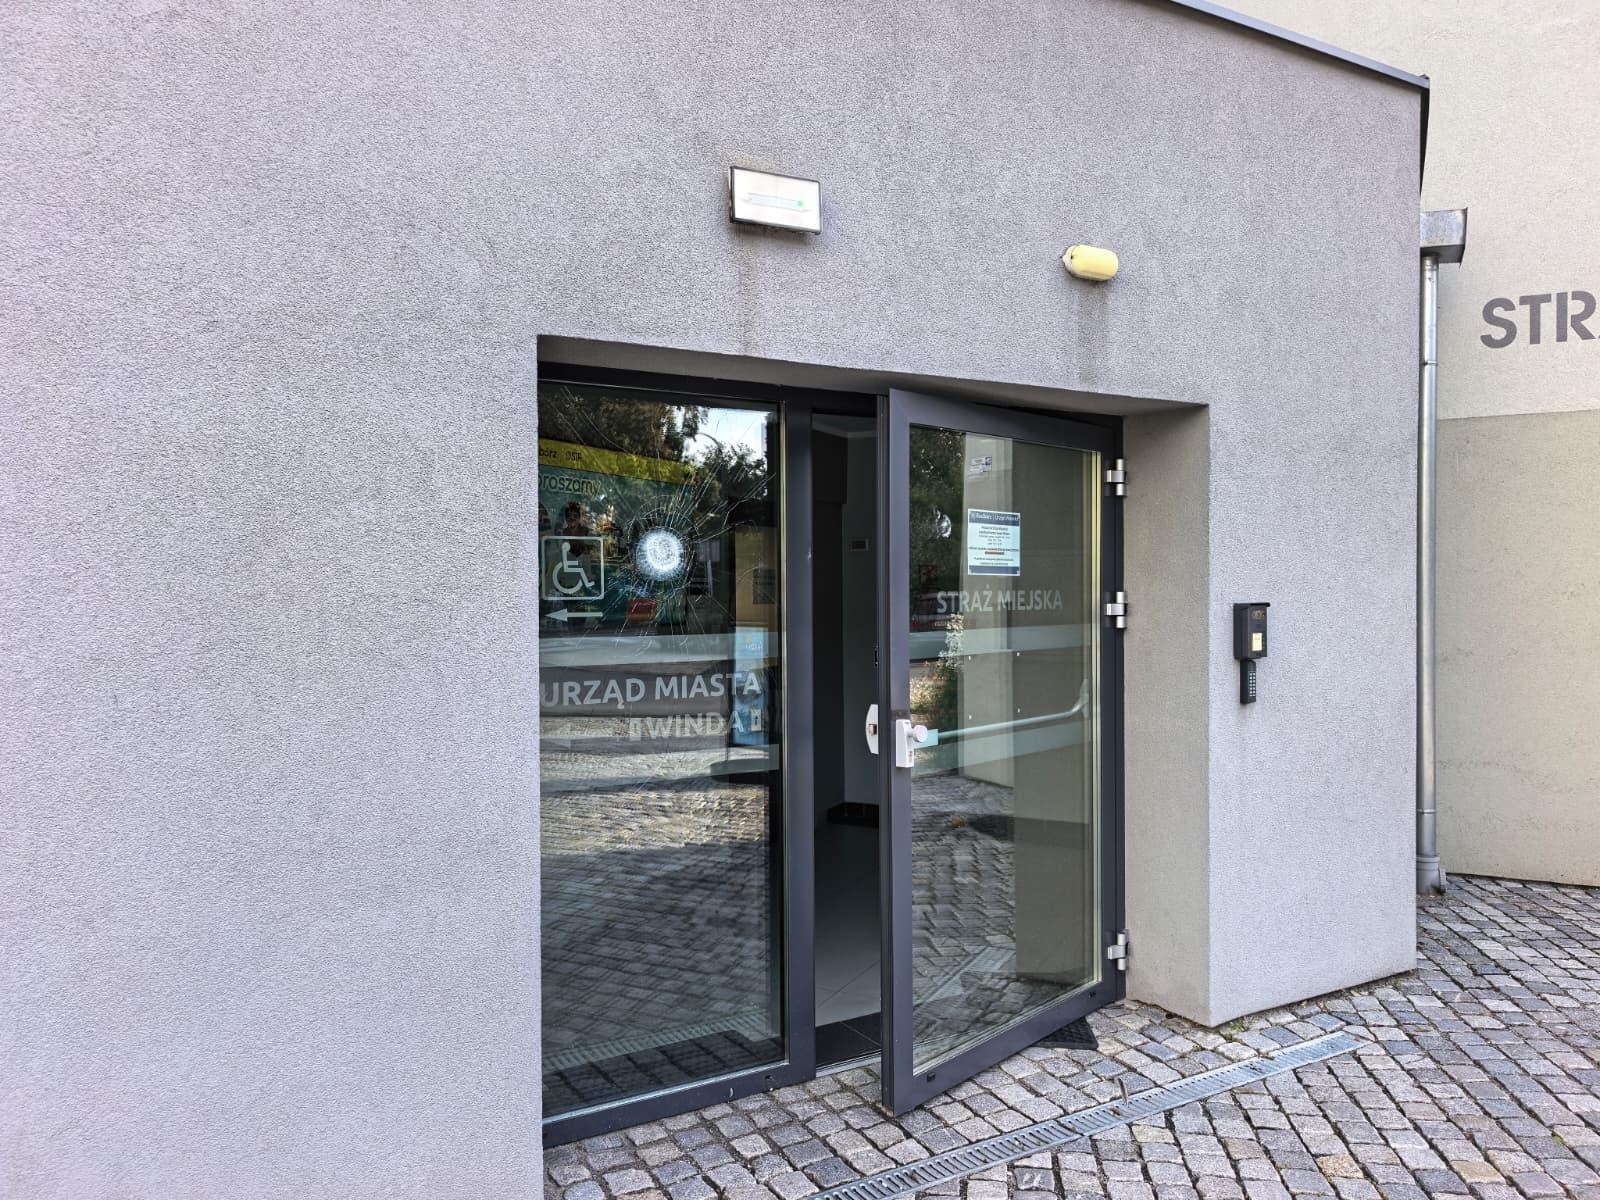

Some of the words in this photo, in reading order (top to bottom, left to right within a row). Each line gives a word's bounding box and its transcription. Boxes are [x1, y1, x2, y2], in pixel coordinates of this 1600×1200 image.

[1480, 290, 1600, 349] STR
[936, 584, 994, 614] STRAŻ
[997, 588, 1063, 612] MIEJSKA
[540, 677, 646, 710] URZĄD
[655, 671, 761, 701] MIASTA
[645, 710, 744, 740] WINDA
